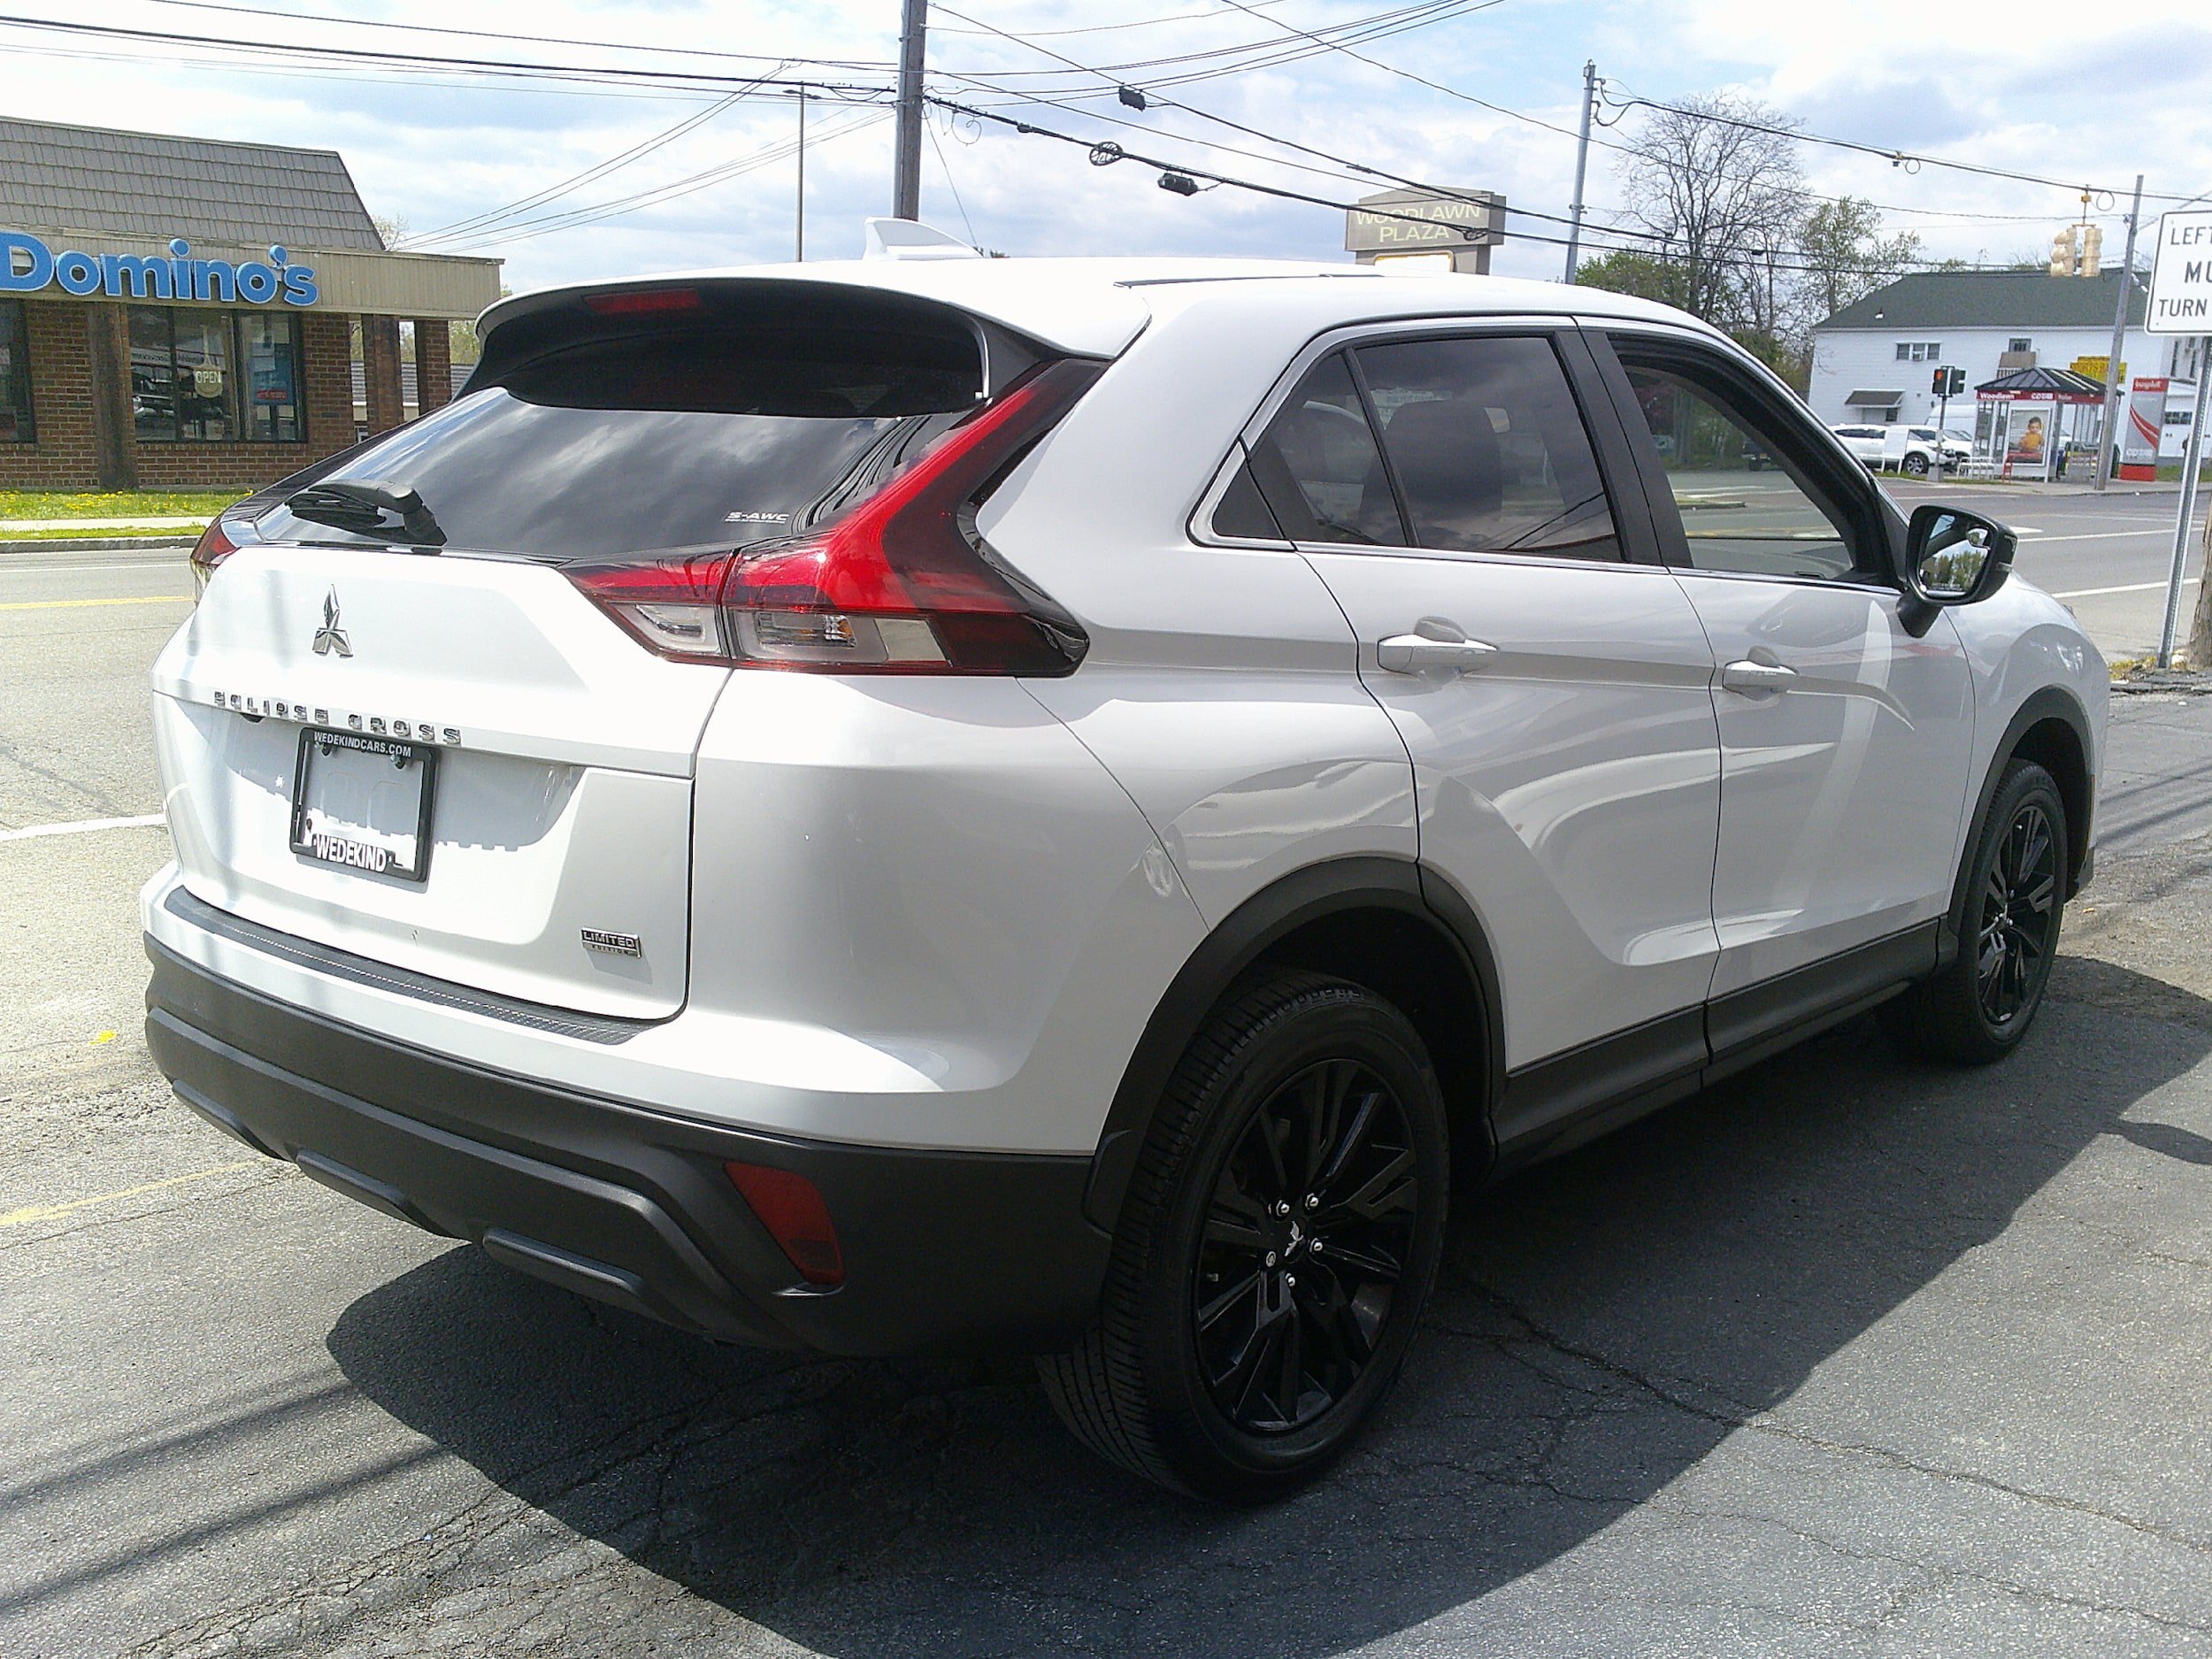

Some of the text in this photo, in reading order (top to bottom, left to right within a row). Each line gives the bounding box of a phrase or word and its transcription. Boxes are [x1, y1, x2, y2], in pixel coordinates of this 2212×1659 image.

[1356, 204, 1480, 224] WOODLAWN
[1379, 225, 1449, 242] PLAZA
[0, 231, 319, 306] Domino's
[2159, 298, 2208, 317] TURN
[195, 370, 221, 384] OPEN
[727, 511, 789, 521] S-AWC
[214, 691, 461, 744] ECLIPSE CROSS
[314, 732, 411, 757] WEDEKINDCARS.COM
[315, 836, 387, 872] WEDEKIND
[583, 932, 634, 949] LIMITED
[592, 944, 629, 954] EDITION
